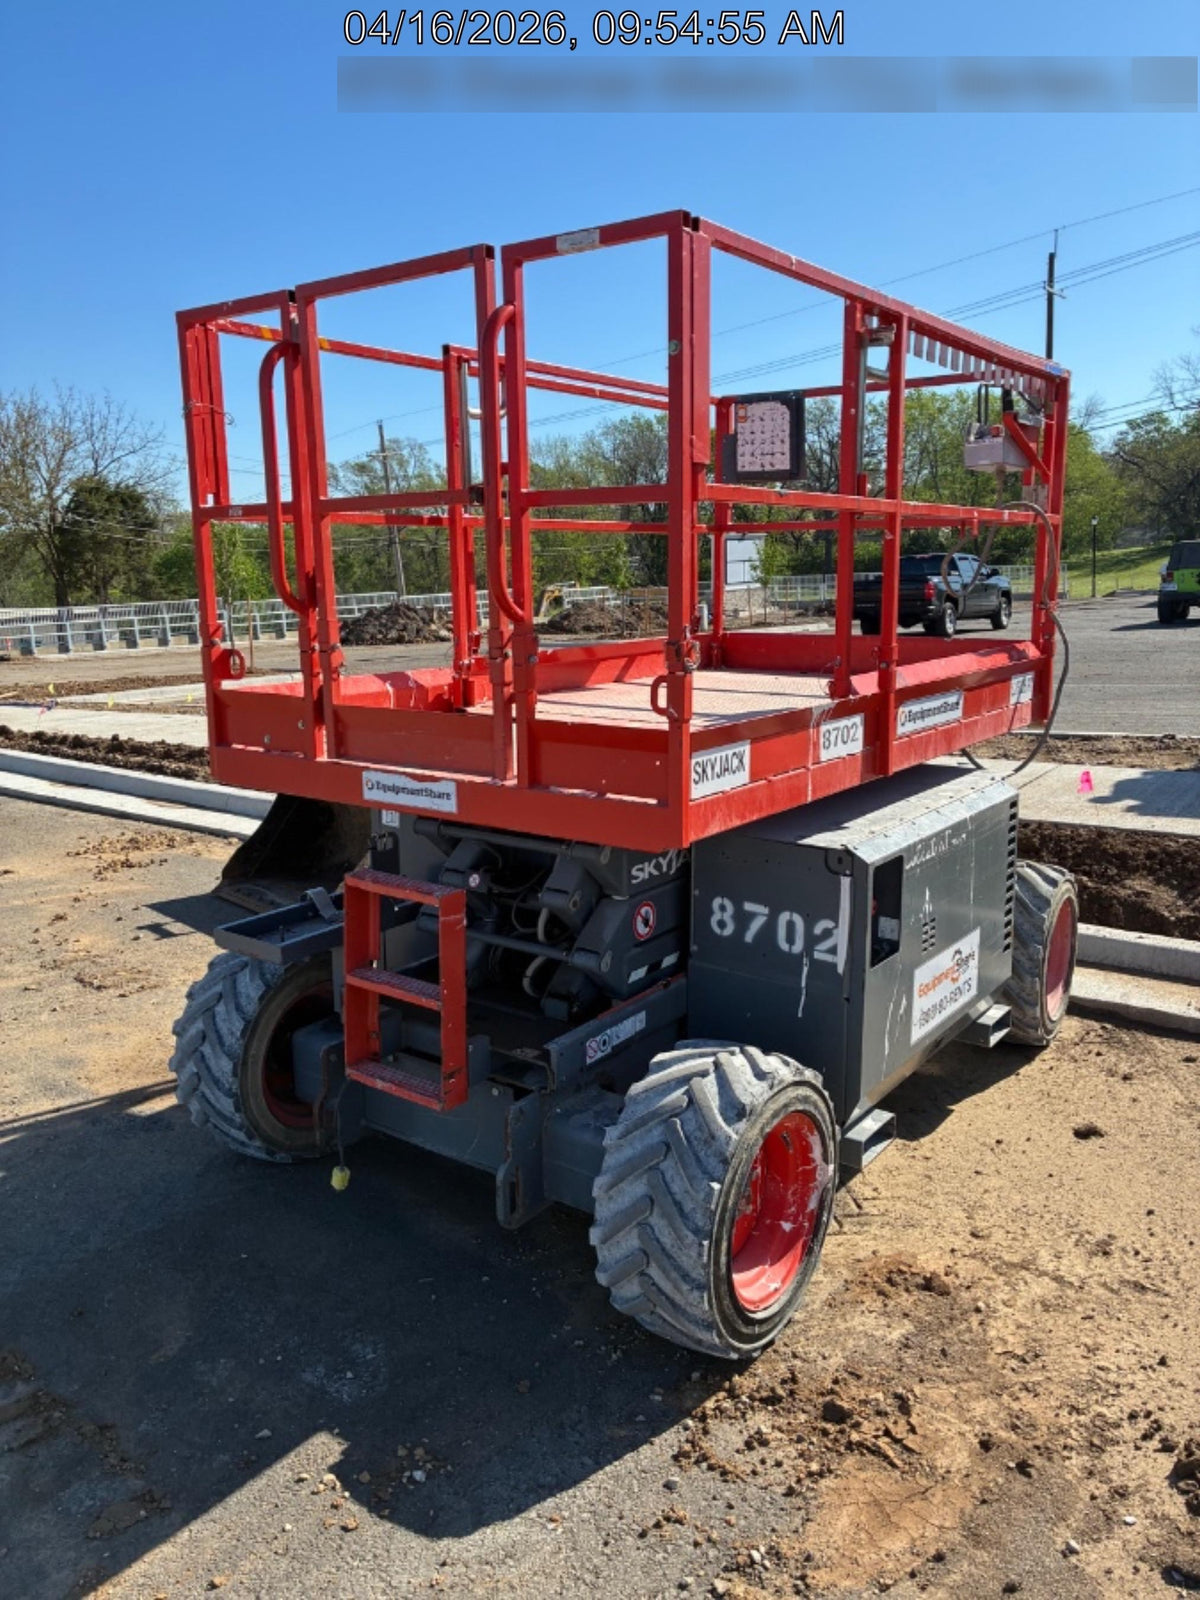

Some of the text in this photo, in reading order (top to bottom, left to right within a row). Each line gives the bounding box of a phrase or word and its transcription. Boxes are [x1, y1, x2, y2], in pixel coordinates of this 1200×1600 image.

[908, 700, 960, 724] EquipmentShare
[823, 722, 859, 750] 8702
[693, 750, 746, 785] SKYJACK
[374, 781, 452, 801] EquipmentShare
[710, 896, 840, 963] 8702
